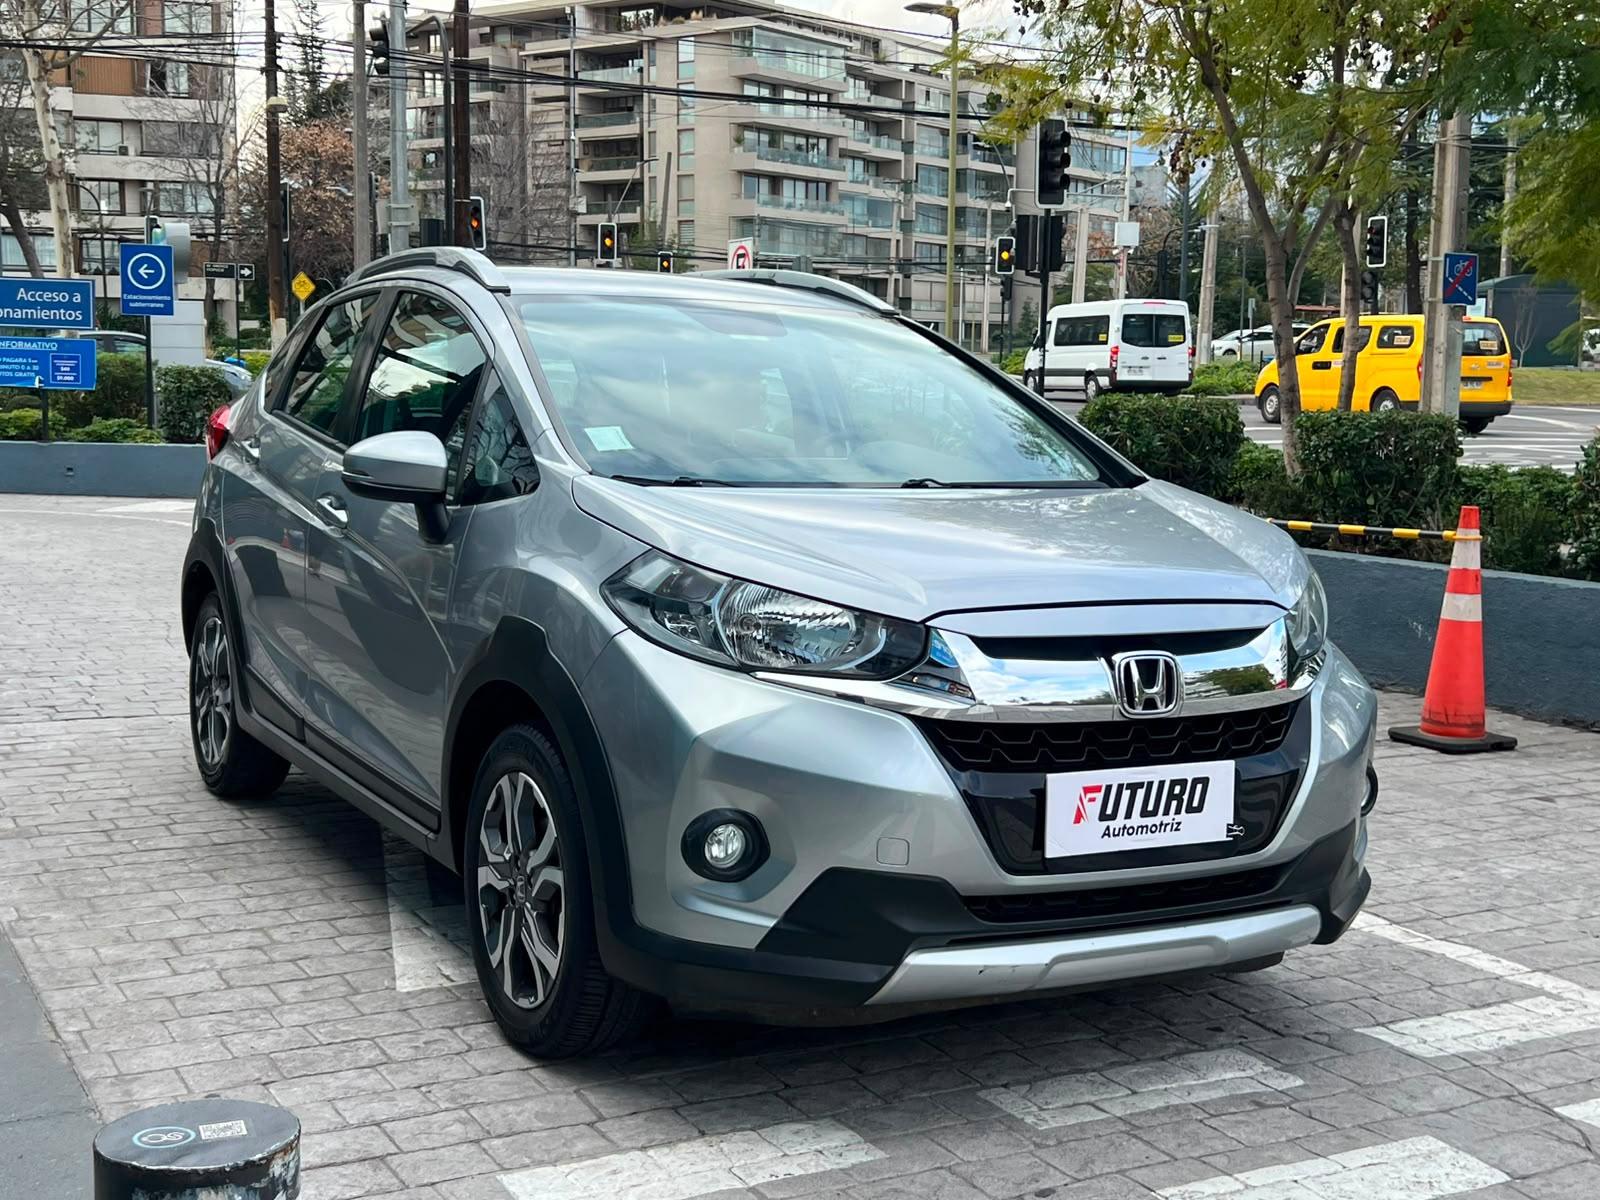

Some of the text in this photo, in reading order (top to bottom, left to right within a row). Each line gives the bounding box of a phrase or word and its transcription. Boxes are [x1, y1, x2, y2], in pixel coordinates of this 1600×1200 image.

[16, 287, 81, 302] Acceso a
[1073, 776, 1210, 825] FUTURO
[1101, 818, 1182, 839] Automotriz
